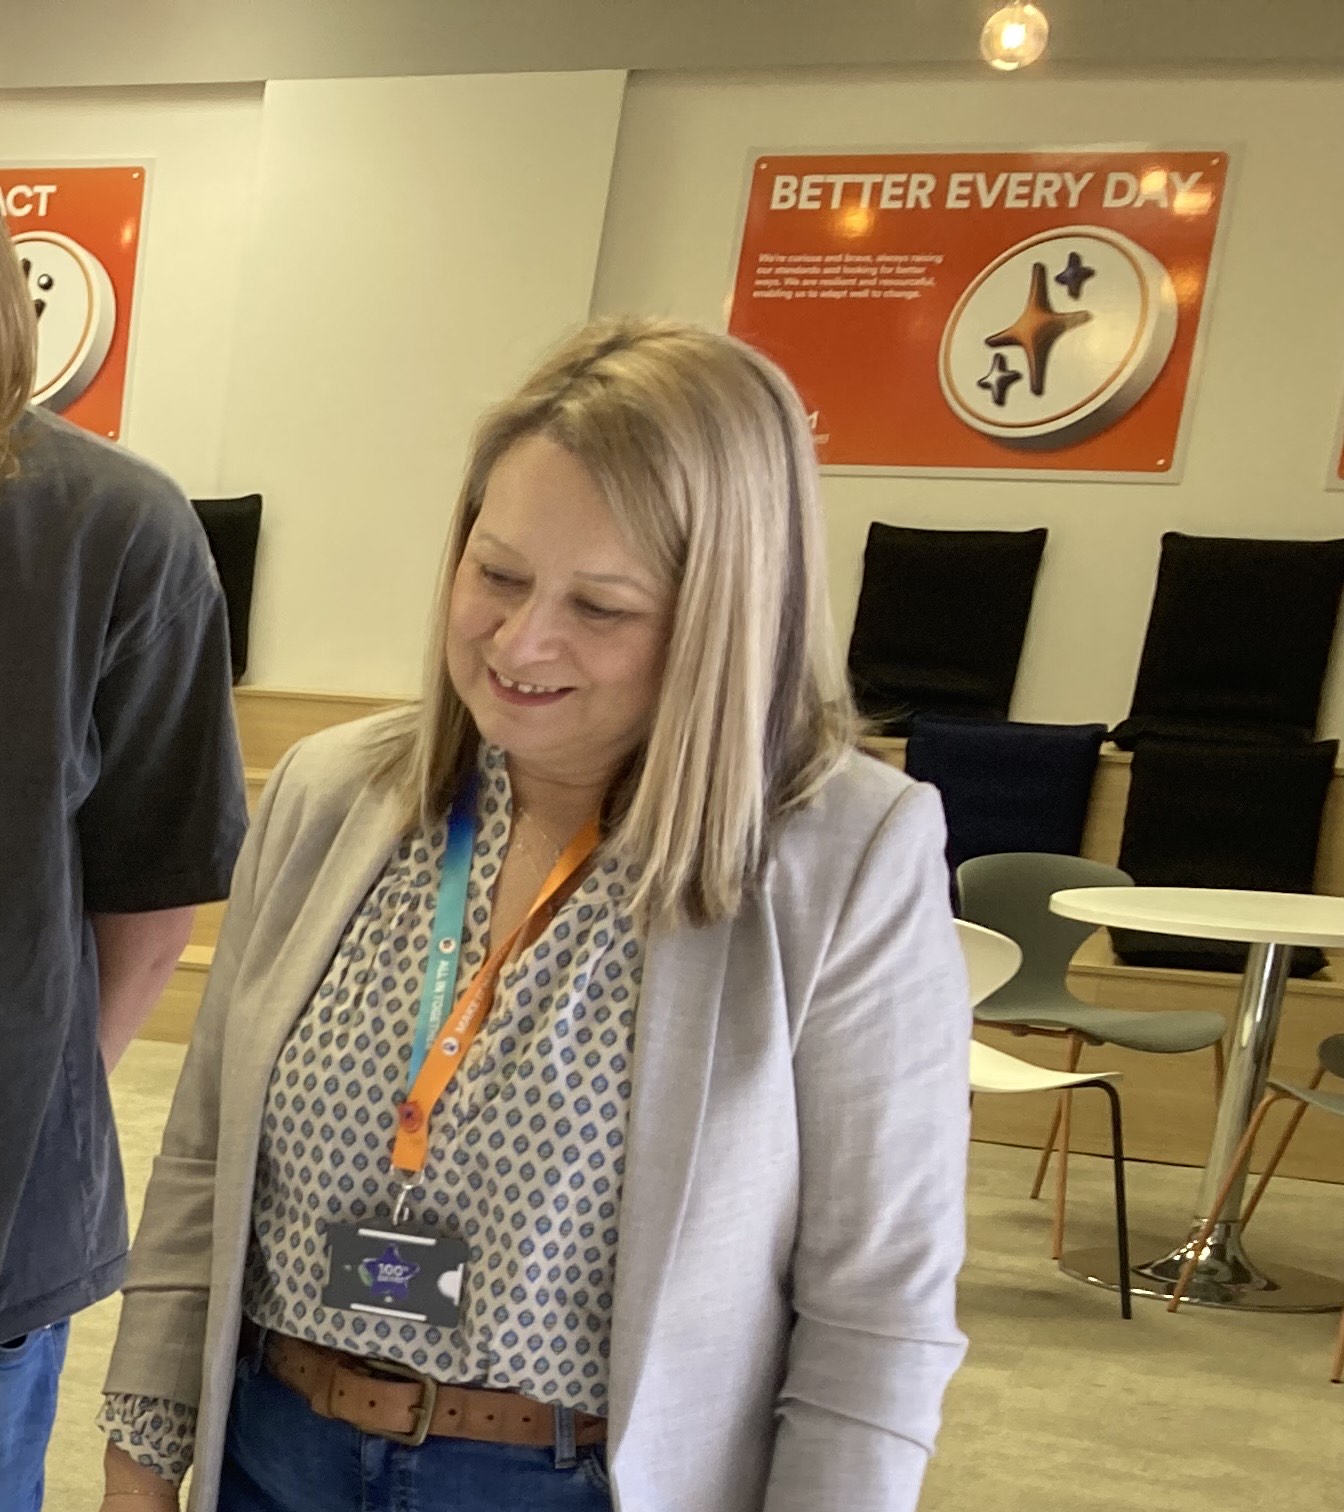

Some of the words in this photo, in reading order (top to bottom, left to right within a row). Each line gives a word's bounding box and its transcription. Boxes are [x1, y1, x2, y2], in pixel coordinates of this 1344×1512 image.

[770, 173, 937, 211] BETTER
[945, 172, 1091, 210] EVERY
[1102, 171, 1203, 209] DAY
